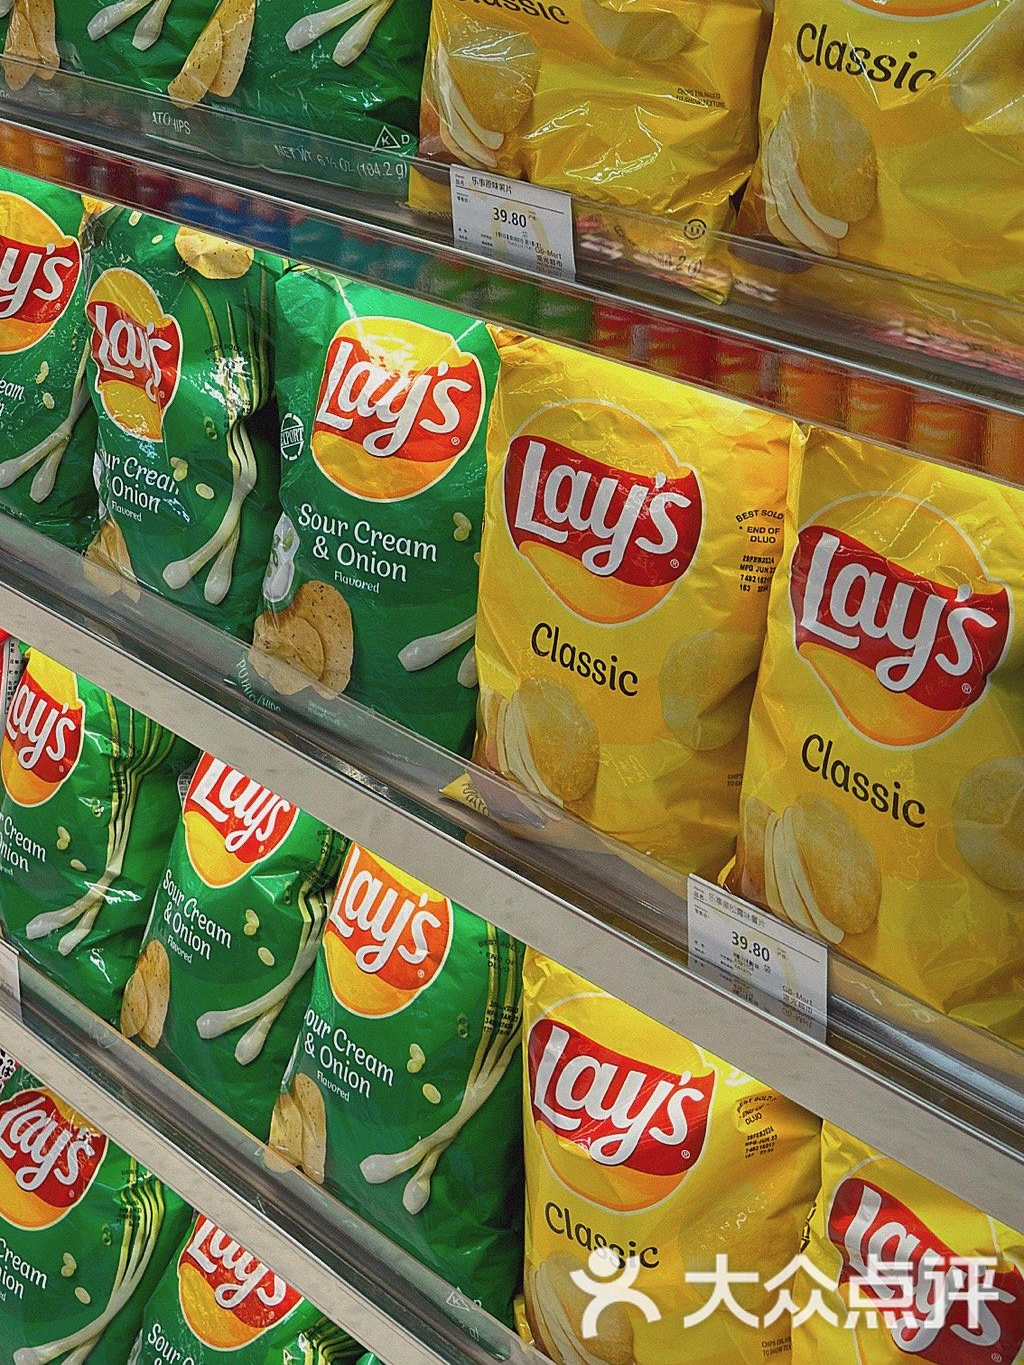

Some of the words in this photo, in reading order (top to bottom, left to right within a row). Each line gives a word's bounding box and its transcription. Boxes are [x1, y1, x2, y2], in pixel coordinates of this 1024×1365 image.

[796, 22, 937, 93] Classic
[356, 160, 393, 179] (184.2
[395, 161, 408, 181] g)
[493, 207, 527, 229] 39.80
[317, 340, 473, 459] Lay's
[111, 476, 161, 514] Onion
[112, 500, 143, 522] Flavored
[514, 439, 692, 577] Lay's
[735, 509, 760, 523] BEST
[760, 509, 784, 520] SOLD
[298, 503, 349, 538] Sour
[353, 521, 437, 562] Cream
[746, 525, 766, 535] END
[767, 527, 781, 535] OF
[749, 535, 776, 544] DLUO
[312, 534, 330, 561] &
[336, 543, 407, 583] Onion
[334, 570, 380, 595] Flavored
[800, 531, 997, 693] Lay's
[531, 622, 639, 698] Classic
[801, 732, 927, 829] Classic
[4, 815, 47, 863] Cream
[162, 869, 184, 908] Sour
[184, 897, 232, 949] Cream
[163, 901, 174, 923] &
[173, 914, 212, 961] Onion
[329, 844, 442, 974] Lay's
[167, 934, 193, 964] Flavored
[731, 930, 771, 963] 39.80
[304, 1030, 317, 1056] &
[319, 1044, 372, 1100] Onion
[333, 1026, 395, 1087] Cream
[315, 1070, 351, 1103] Flavored
[532, 1025, 704, 1166] Lay's
[544, 1202, 660, 1269] Classic
[147, 1322, 182, 1365] Sour
